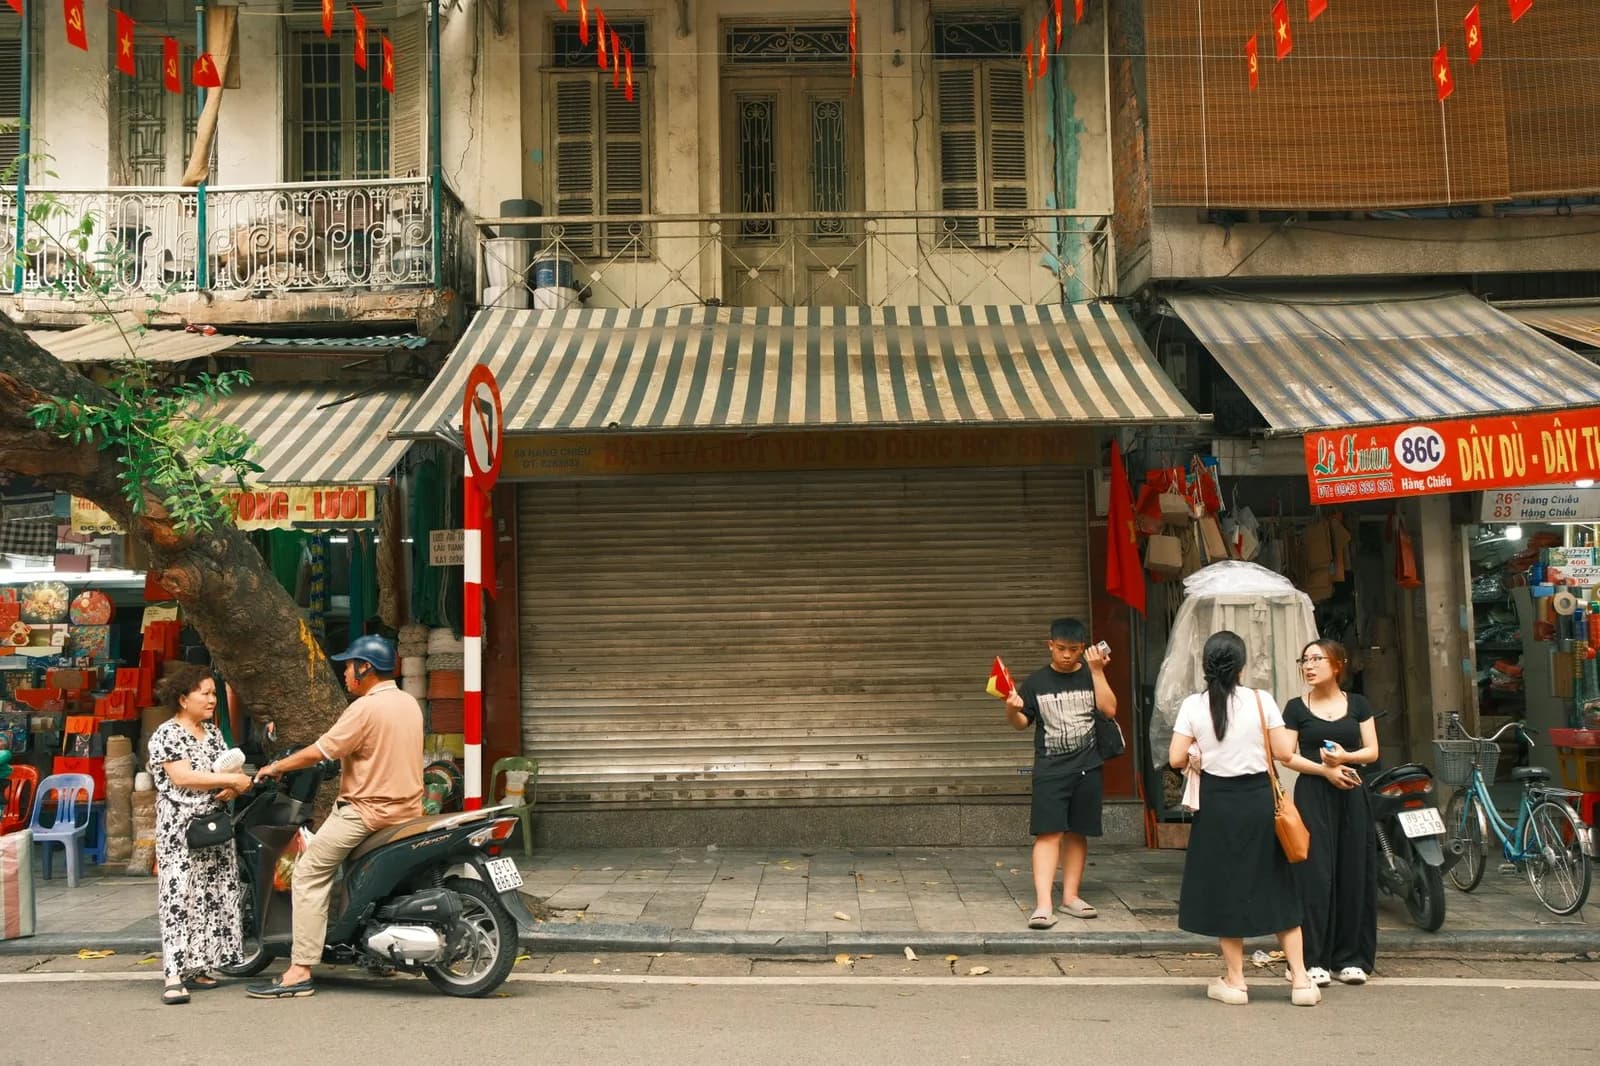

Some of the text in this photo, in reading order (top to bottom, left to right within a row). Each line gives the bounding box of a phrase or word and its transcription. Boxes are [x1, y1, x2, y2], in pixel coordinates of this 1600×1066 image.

[1313, 434, 1392, 475] Lê Xuân
[1402, 435, 1441, 464] 86C
[1457, 424, 1495, 481] DÂY
[1498, 421, 1526, 478] DÙ
[1541, 417, 1578, 474] DÂY
[1401, 474, 1452, 491] Hàng Chiếu
[313, 486, 366, 520] LƯỚI
